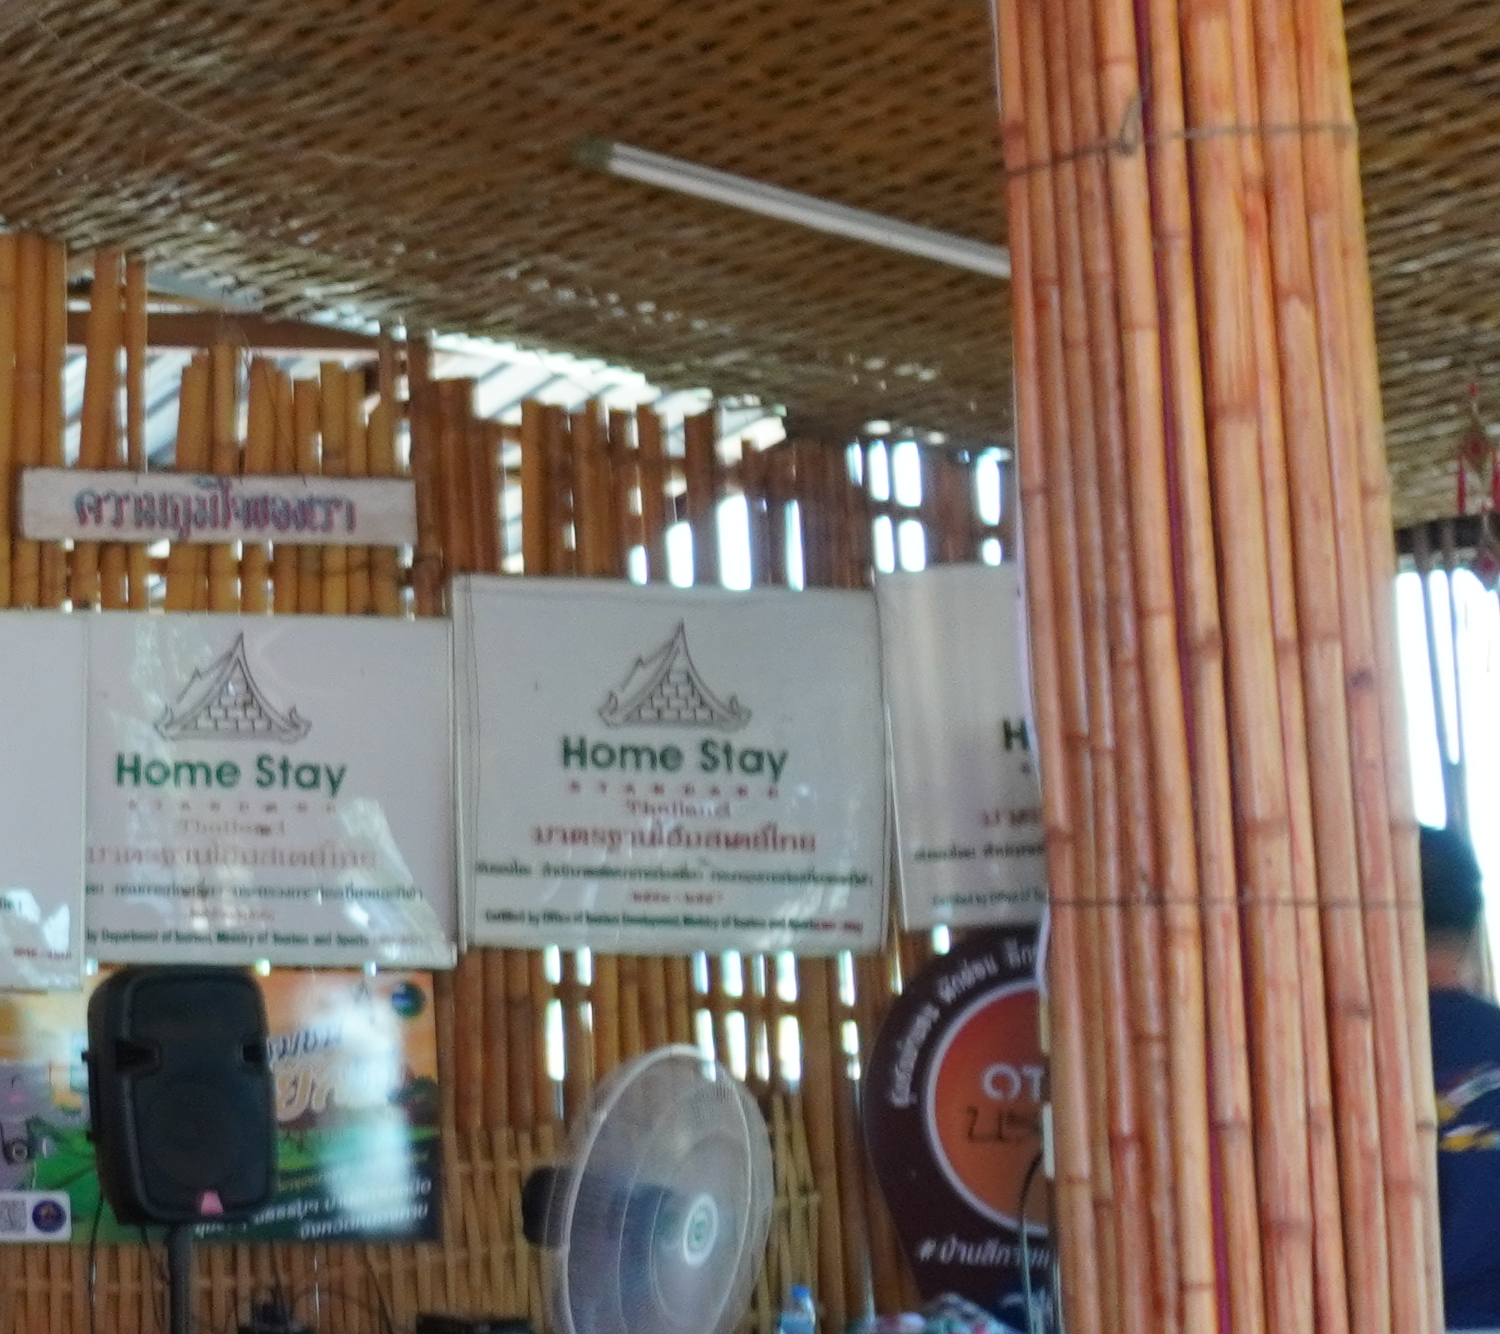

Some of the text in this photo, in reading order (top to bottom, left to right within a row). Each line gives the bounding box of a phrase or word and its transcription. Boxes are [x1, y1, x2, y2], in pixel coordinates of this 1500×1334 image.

[115, 752, 348, 798] Home Stay
[561, 736, 788, 783] Home Stay
